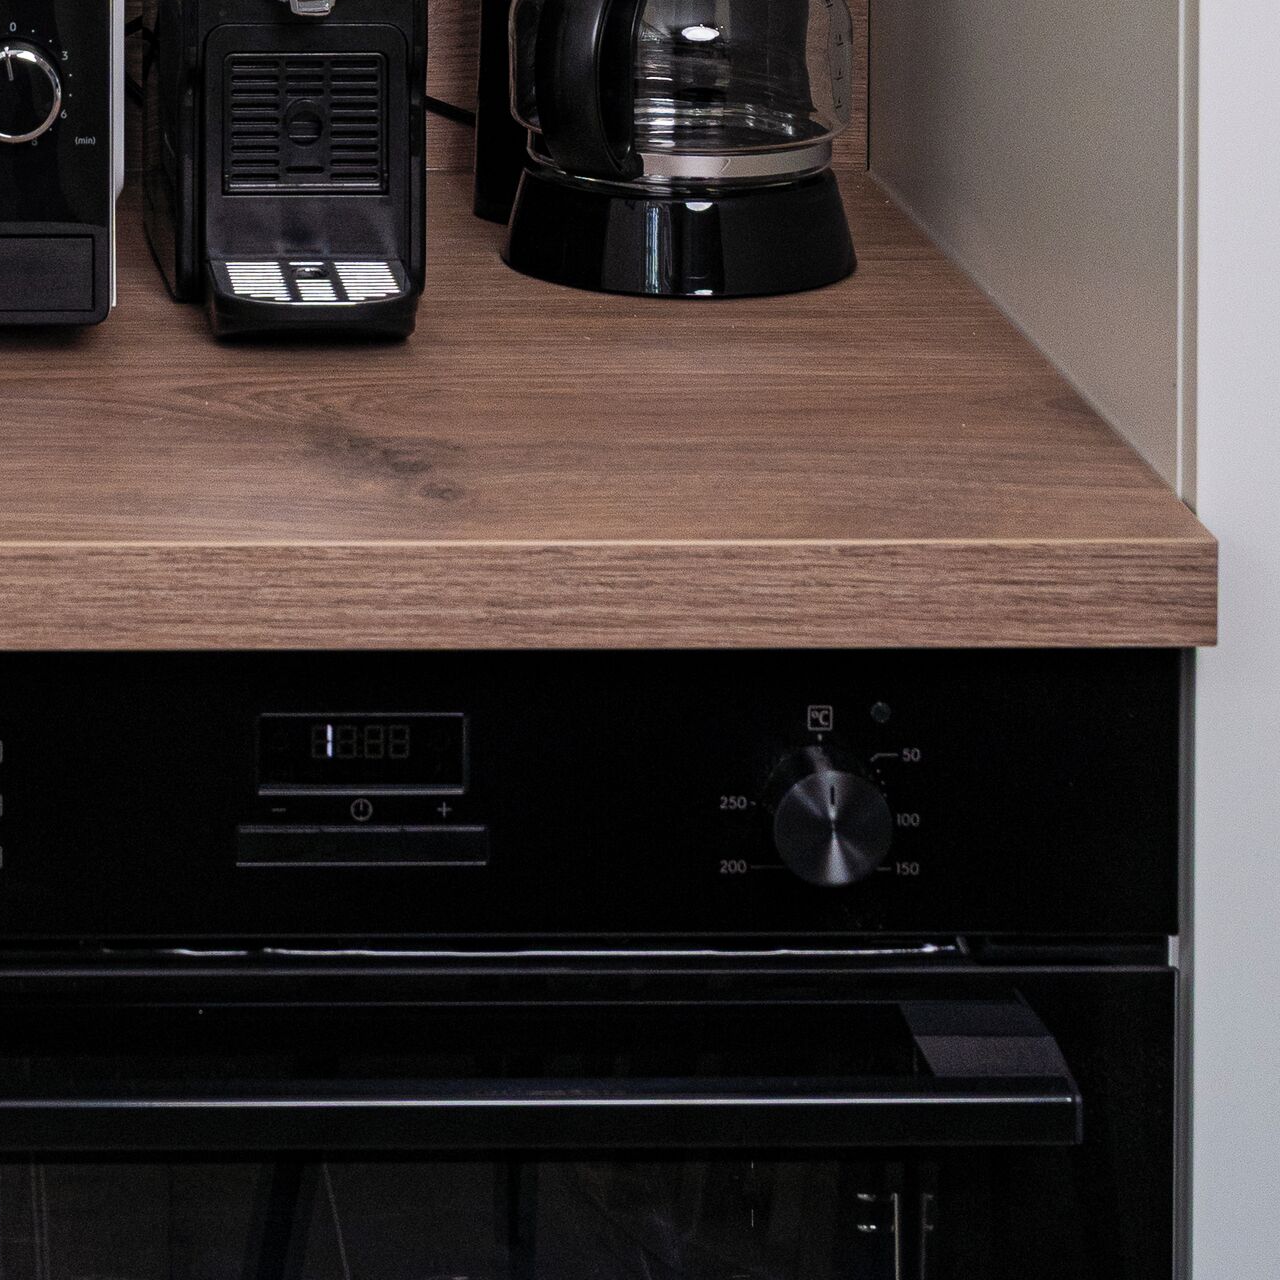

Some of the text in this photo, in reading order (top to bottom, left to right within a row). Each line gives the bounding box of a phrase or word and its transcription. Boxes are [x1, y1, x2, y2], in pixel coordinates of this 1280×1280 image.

[9, 22, 17, 32] 0
[61, 51, 69, 61] 3
[60, 109, 68, 119] 6
[74, 136, 96, 146] (min)
[902, 748, 921, 762] 50
[720, 796, 747, 810] 250
[896, 813, 920, 827] 100
[719, 860, 747, 874] 200
[895, 862, 920, 876] 150
